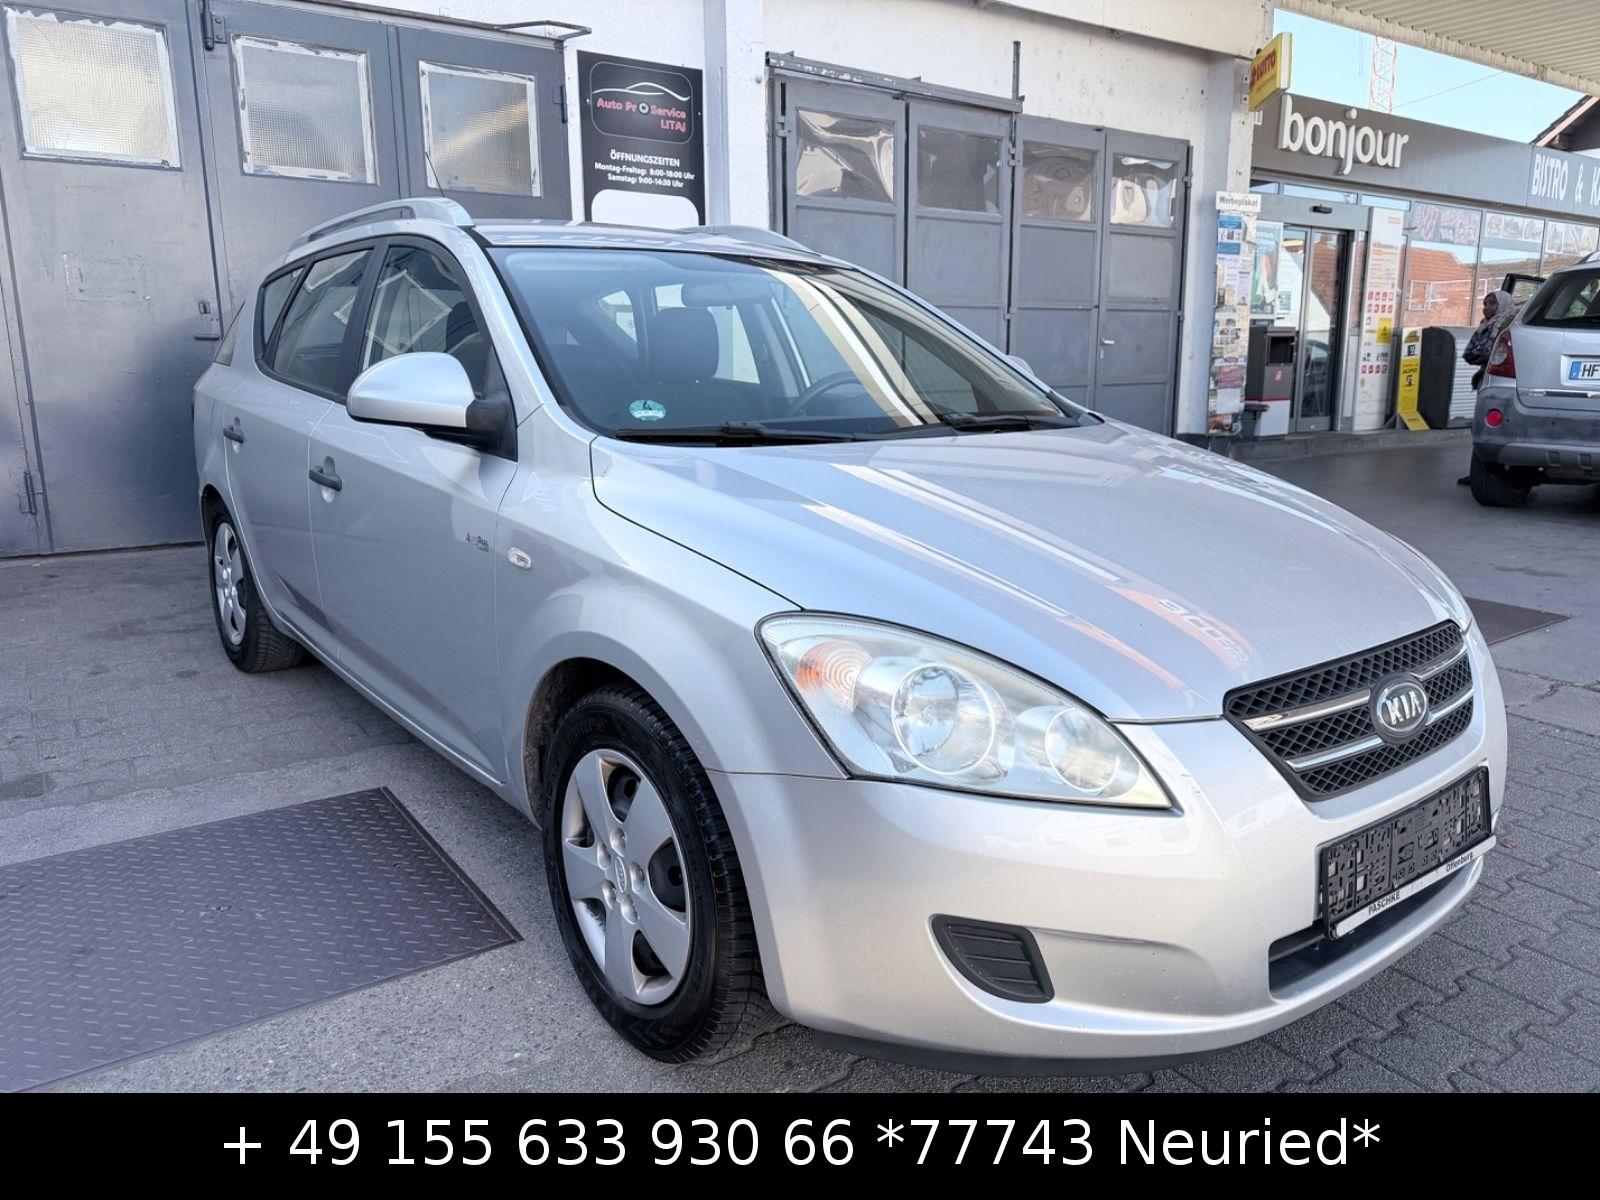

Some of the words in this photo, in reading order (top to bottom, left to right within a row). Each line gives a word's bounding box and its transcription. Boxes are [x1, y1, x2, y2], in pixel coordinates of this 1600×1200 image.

[596, 97, 623, 111] Auto
[650, 105, 687, 119] Service
[1280, 94, 1410, 176] bonjour
[610, 149, 681, 168] ÖFFNUNGSZEITEN
[1531, 153, 1569, 201] BISTRO
[1574, 162, 1584, 204] &
[1385, 690, 1422, 725] KIA
[1367, 891, 1401, 916] PASCHKE
